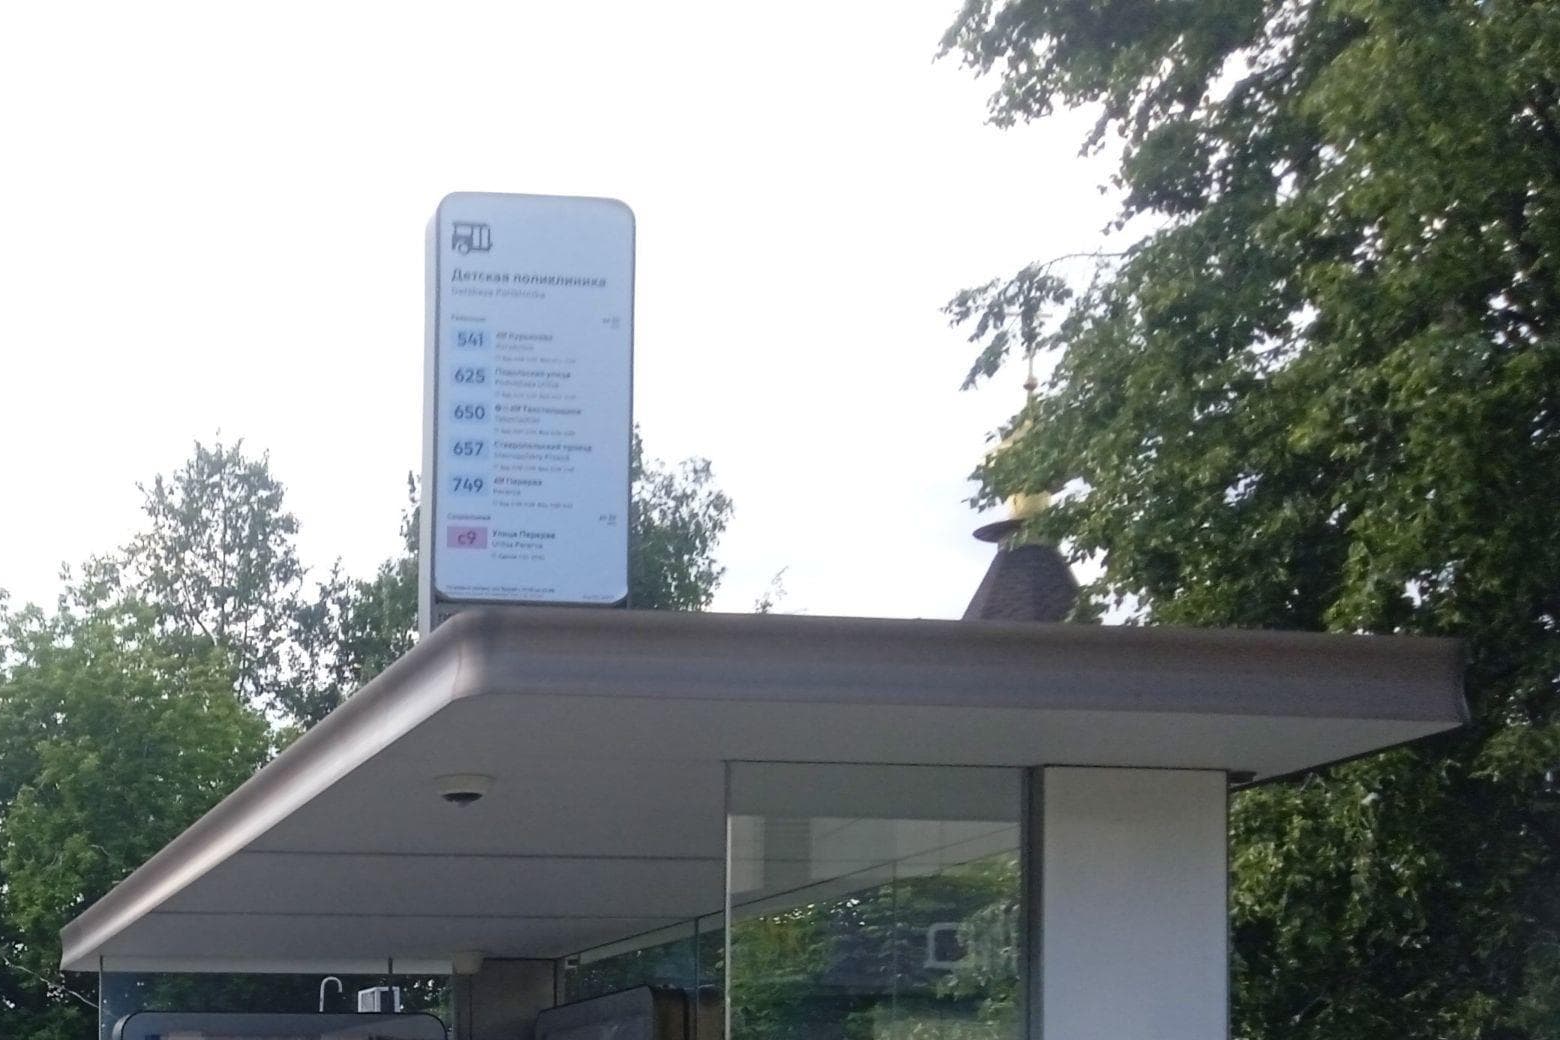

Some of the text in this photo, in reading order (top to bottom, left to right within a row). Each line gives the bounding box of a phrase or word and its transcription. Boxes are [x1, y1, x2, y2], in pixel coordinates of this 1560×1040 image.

[451, 267, 607, 289] Детская поликлиника
[457, 331, 484, 347] 541
[454, 368, 485, 384] 625
[454, 404, 485, 420] 650
[453, 440, 484, 457] 657
[453, 477, 484, 493] 749
